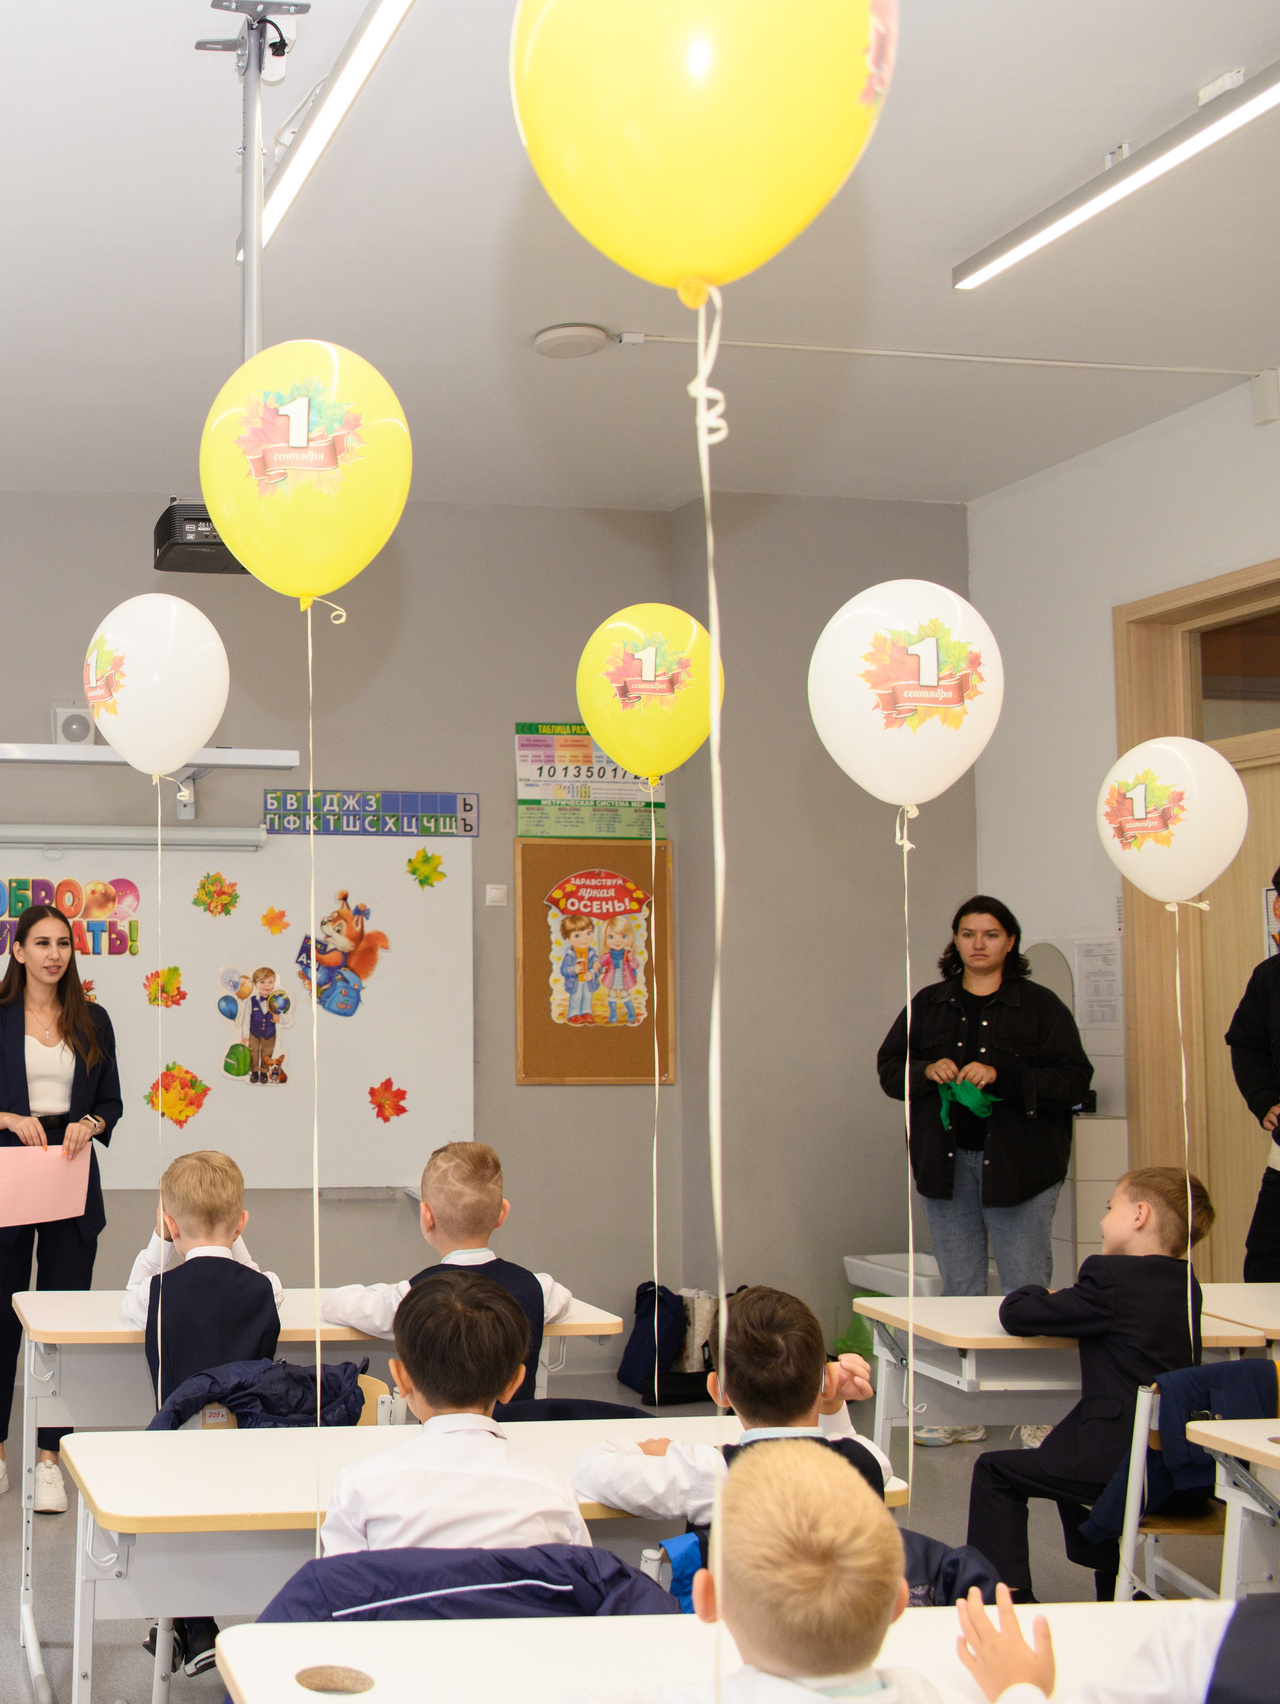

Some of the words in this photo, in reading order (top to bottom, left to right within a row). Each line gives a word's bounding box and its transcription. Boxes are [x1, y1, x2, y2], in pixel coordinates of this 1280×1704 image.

[278, 396, 309, 447] 1
[273, 450, 325, 463] сентября
[633, 646, 656, 681] 1
[907, 637, 938, 687] 1
[903, 688, 953, 701] сентября
[538, 724, 571, 734] ТАБЛИЦА
[1125, 783, 1147, 820] 1
[577, 888, 616, 900] яркая
[566, 897, 631, 913] ОСЕНЬ!
